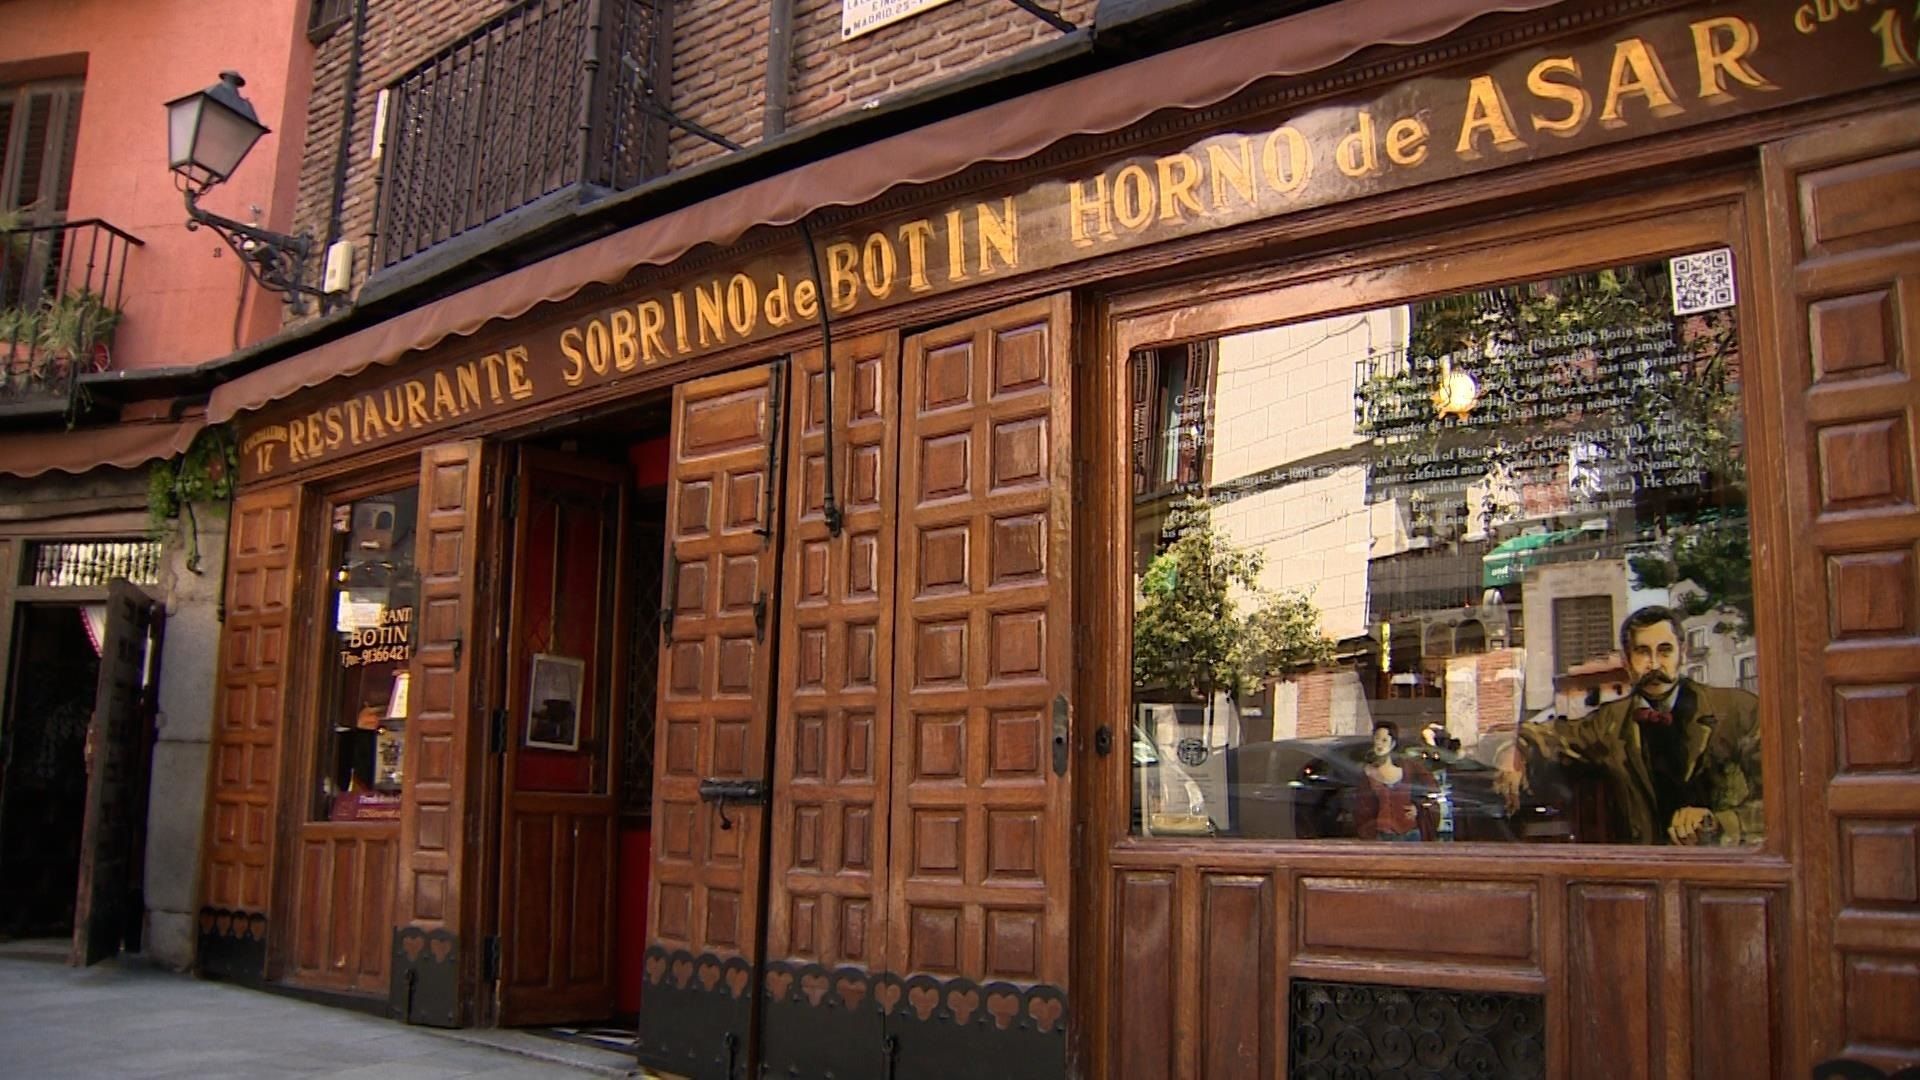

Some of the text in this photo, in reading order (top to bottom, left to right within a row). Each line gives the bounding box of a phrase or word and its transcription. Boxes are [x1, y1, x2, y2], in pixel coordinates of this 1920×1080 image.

[289, 16, 1782, 464] RESTAURANTE SOBRINO de BOTIN HORNO de ASAR
[256, 443, 275, 474] 17
[1643, 473, 1663, 488] He
[351, 625, 408, 648] BOTIN
